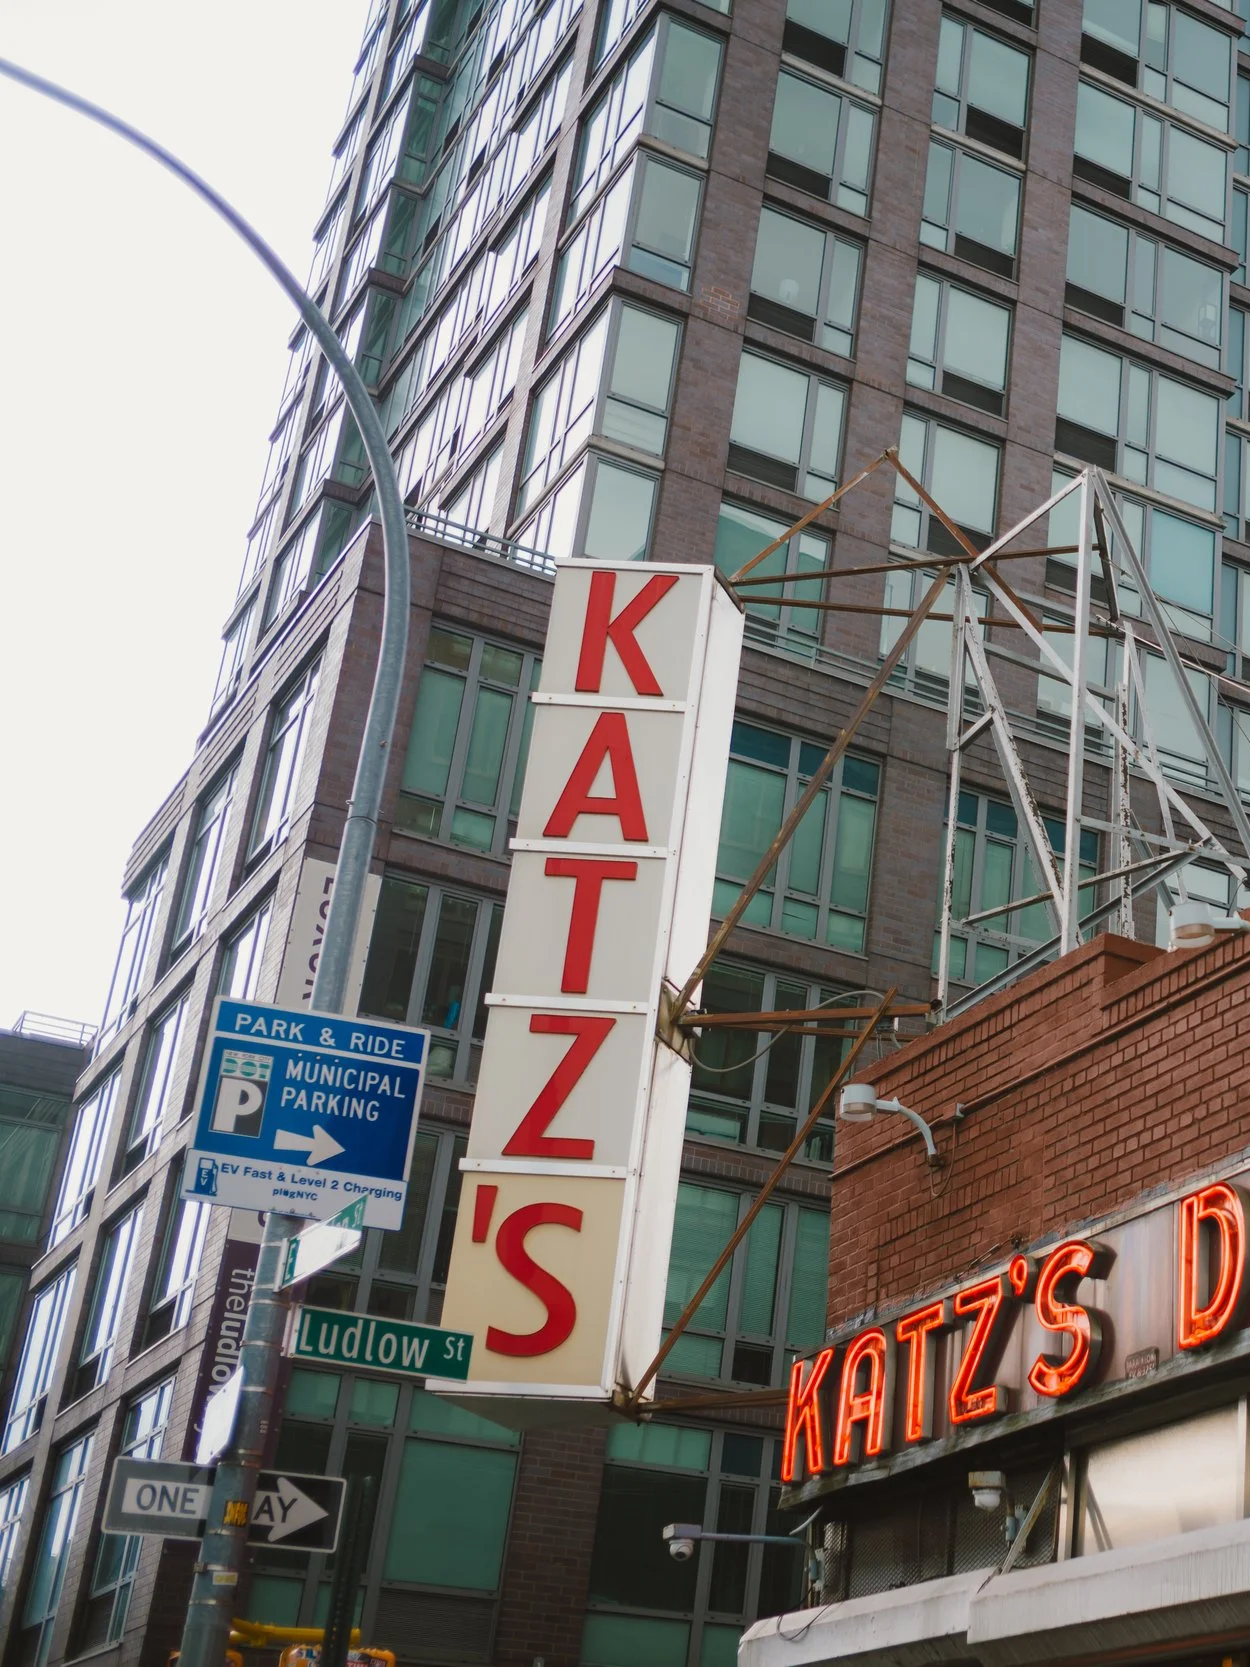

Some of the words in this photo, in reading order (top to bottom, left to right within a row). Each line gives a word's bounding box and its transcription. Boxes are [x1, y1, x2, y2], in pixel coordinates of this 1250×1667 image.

[472, 571, 680, 1358] KATZ'S
[235, 1013, 305, 1041] PARK
[319, 1027, 336, 1047] &
[350, 1032, 406, 1058] RIDE
[222, 1057, 271, 1080] DOT
[285, 1058, 406, 1099] MUNICIPAL
[213, 1077, 263, 1133] P
[280, 1086, 380, 1122] PARKING
[221, 1162, 240, 1175] EV
[243, 1166, 273, 1181] Fast
[276, 1171, 286, 1183] &
[291, 1172, 327, 1189] Level
[331, 1179, 340, 1190] 2
[343, 1181, 403, 1202] Charging
[299, 1313, 430, 1369] Ludlow
[443, 1335, 467, 1361] St
[781, 1239, 1096, 1483] KATZ'S
[135, 1483, 200, 1516] ONE
[252, 1493, 299, 1524] AY
